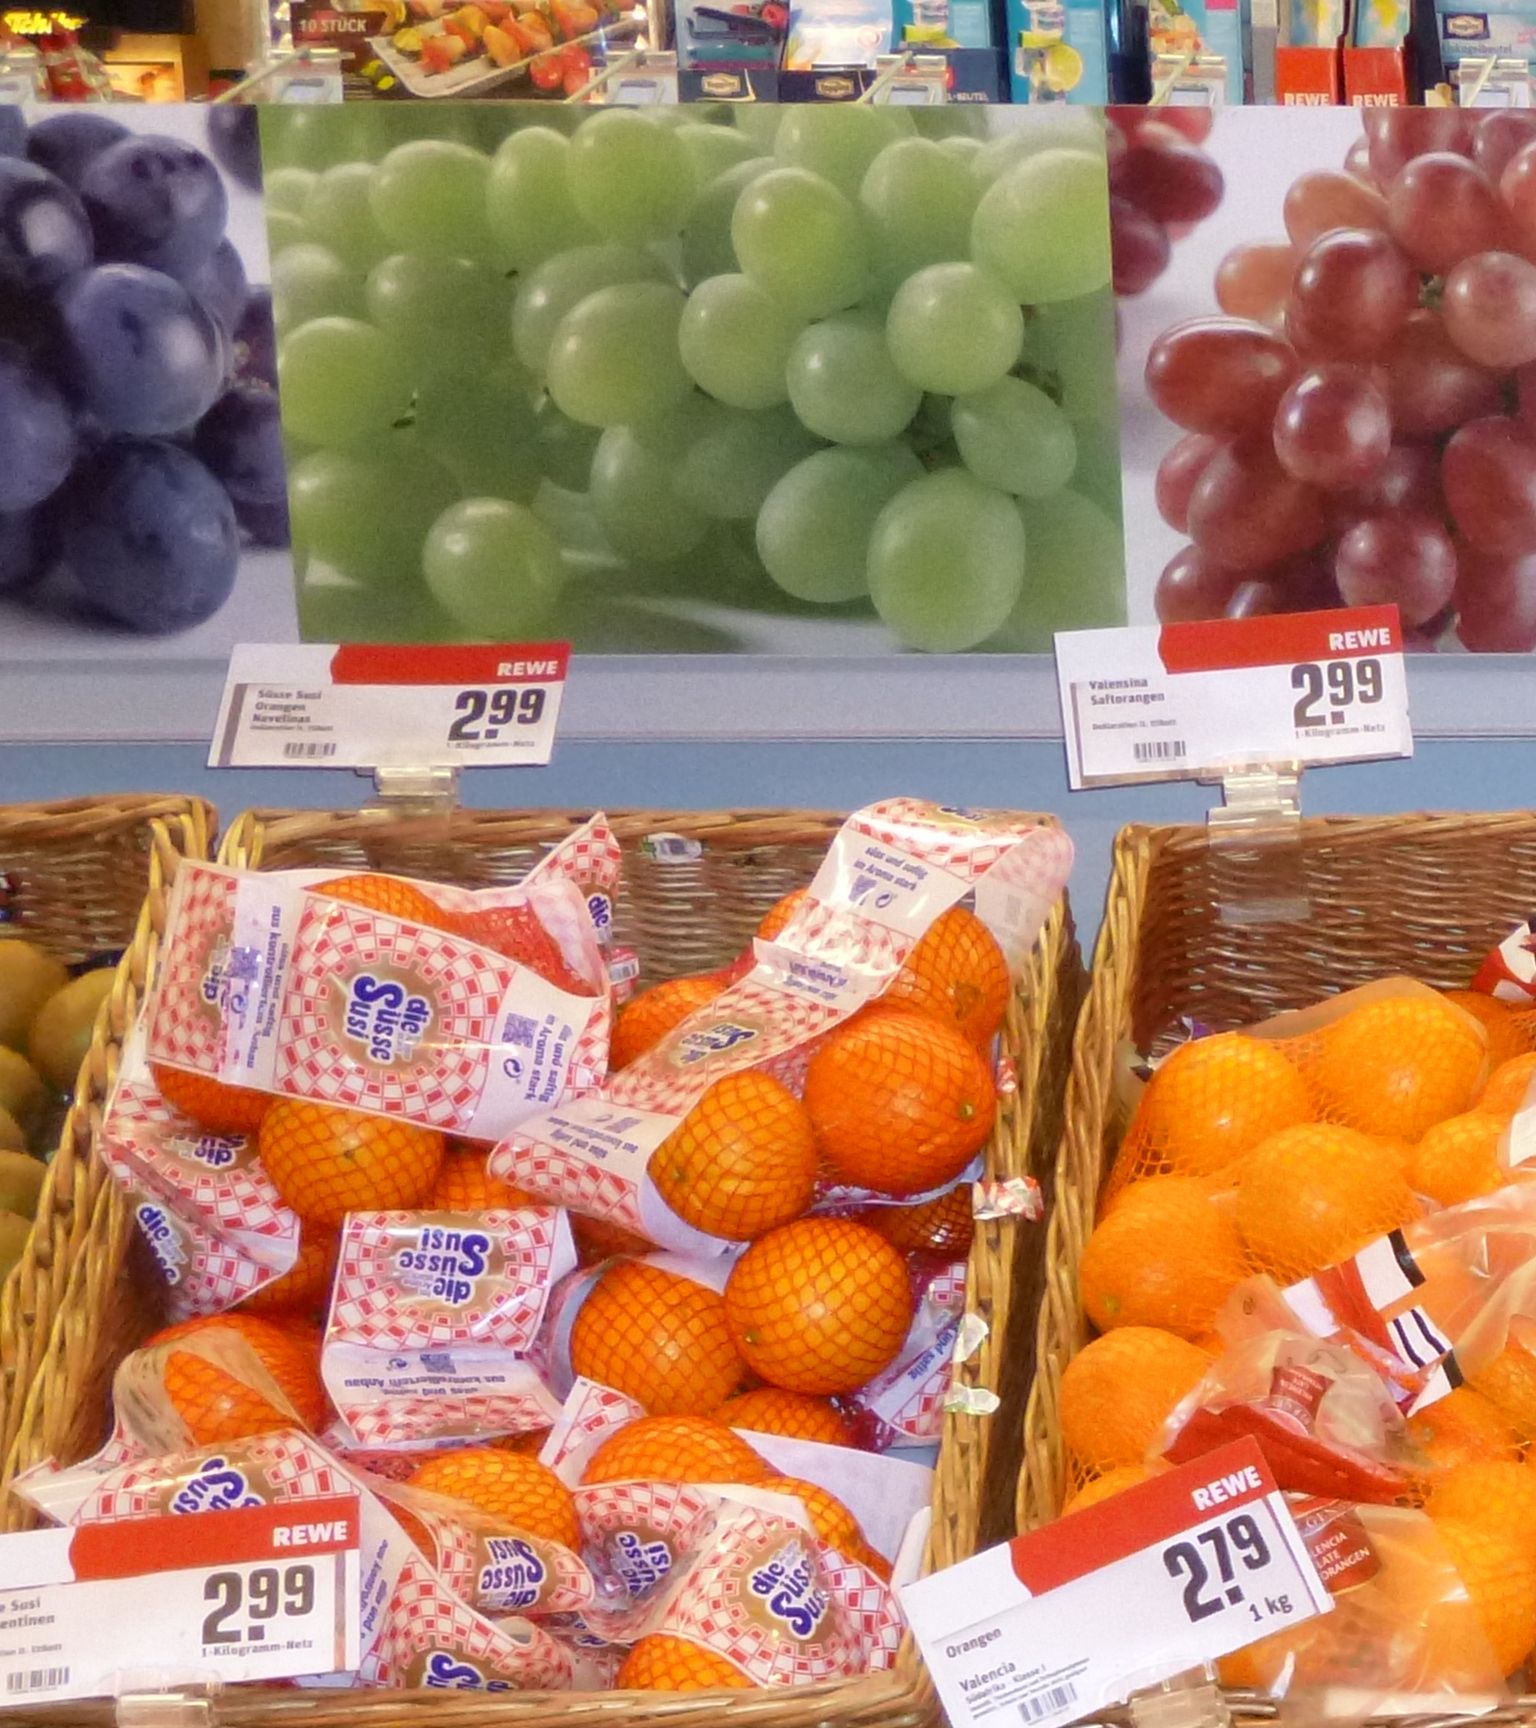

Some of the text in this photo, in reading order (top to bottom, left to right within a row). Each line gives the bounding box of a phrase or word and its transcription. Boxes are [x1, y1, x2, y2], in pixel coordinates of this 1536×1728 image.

[300, 17, 367, 33] 10 STÜCK
[1284, 93, 1330, 106] REWE
[1353, 93, 1398, 106] REWE
[1329, 627, 1391, 651] REWE
[497, 660, 558, 677] REWE
[1088, 677, 1149, 691] Valensina
[1090, 691, 1166, 706] Saftorangen
[1290, 658, 1384, 728] 2.99
[255, 702, 306, 713] Orangen
[447, 687, 547, 742] 2.99
[408, 995, 431, 1037] die
[525, 1069, 541, 1100] stark
[538, 1070, 558, 1102] saftig
[434, 1277, 471, 1304] die
[1190, 1464, 1264, 1512] REWE
[273, 1520, 348, 1547] REWE
[752, 1559, 786, 1595] die
[1162, 1513, 1272, 1624] 2.79
[1320, 1546, 1371, 1581] ORANGEN
[10, 1597, 41, 1611] Susi
[201, 1563, 315, 1646] 2.99
[1248, 1593, 1294, 1623] 1 kg
[945, 1627, 1003, 1660] Orangen
[959, 1659, 1017, 1693] Valencia
